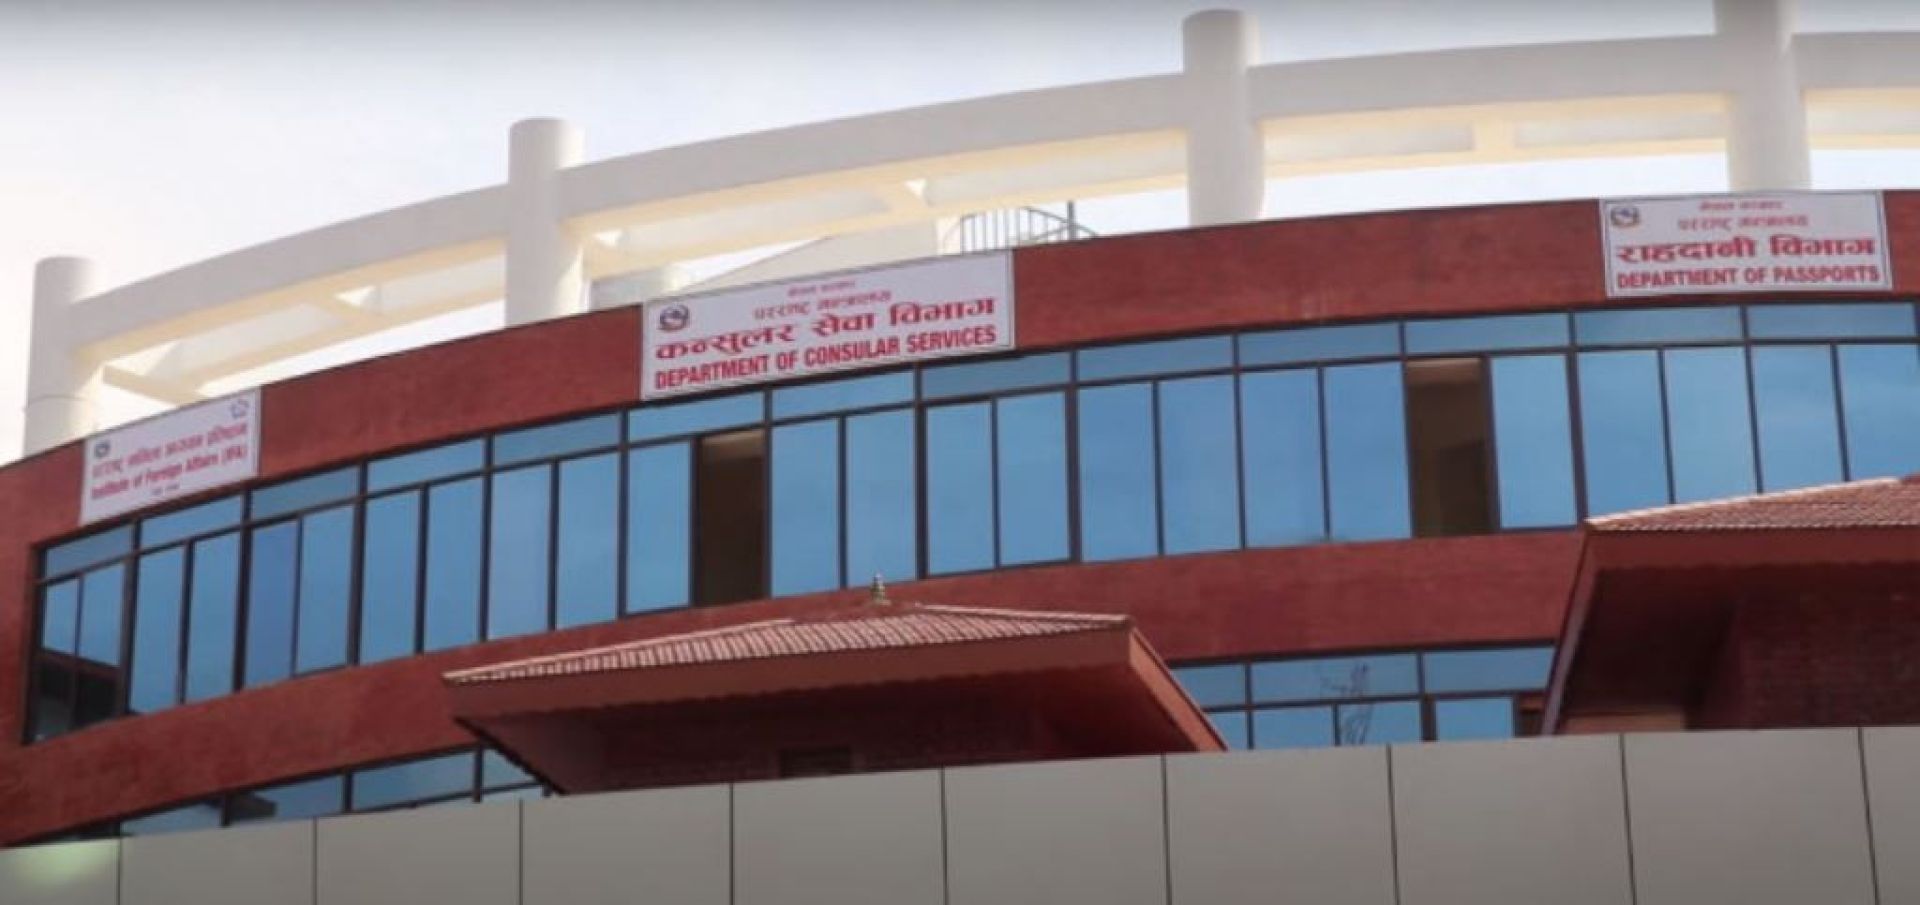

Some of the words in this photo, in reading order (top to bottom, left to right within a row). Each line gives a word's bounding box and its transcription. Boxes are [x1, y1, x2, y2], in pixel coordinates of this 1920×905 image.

[1617, 235, 1756, 263] राहदानी
[1769, 233, 1876, 256] विभाग
[1617, 267, 1738, 289] DEPARTMENT
[1743, 266, 1769, 284] OF
[1773, 265, 1881, 284] PASSPORTS
[655, 324, 796, 361] कन्सुलर
[811, 312, 875, 337] सेवा
[889, 296, 996, 327] विभाग
[655, 354, 769, 391] DEPARTMENT
[776, 350, 800, 370] OF
[804, 337, 900, 368] CONSULAR
[906, 324, 998, 354] SERVICES
[145, 463, 183, 482] Foreign
[186, 453, 219, 473] Affairs
